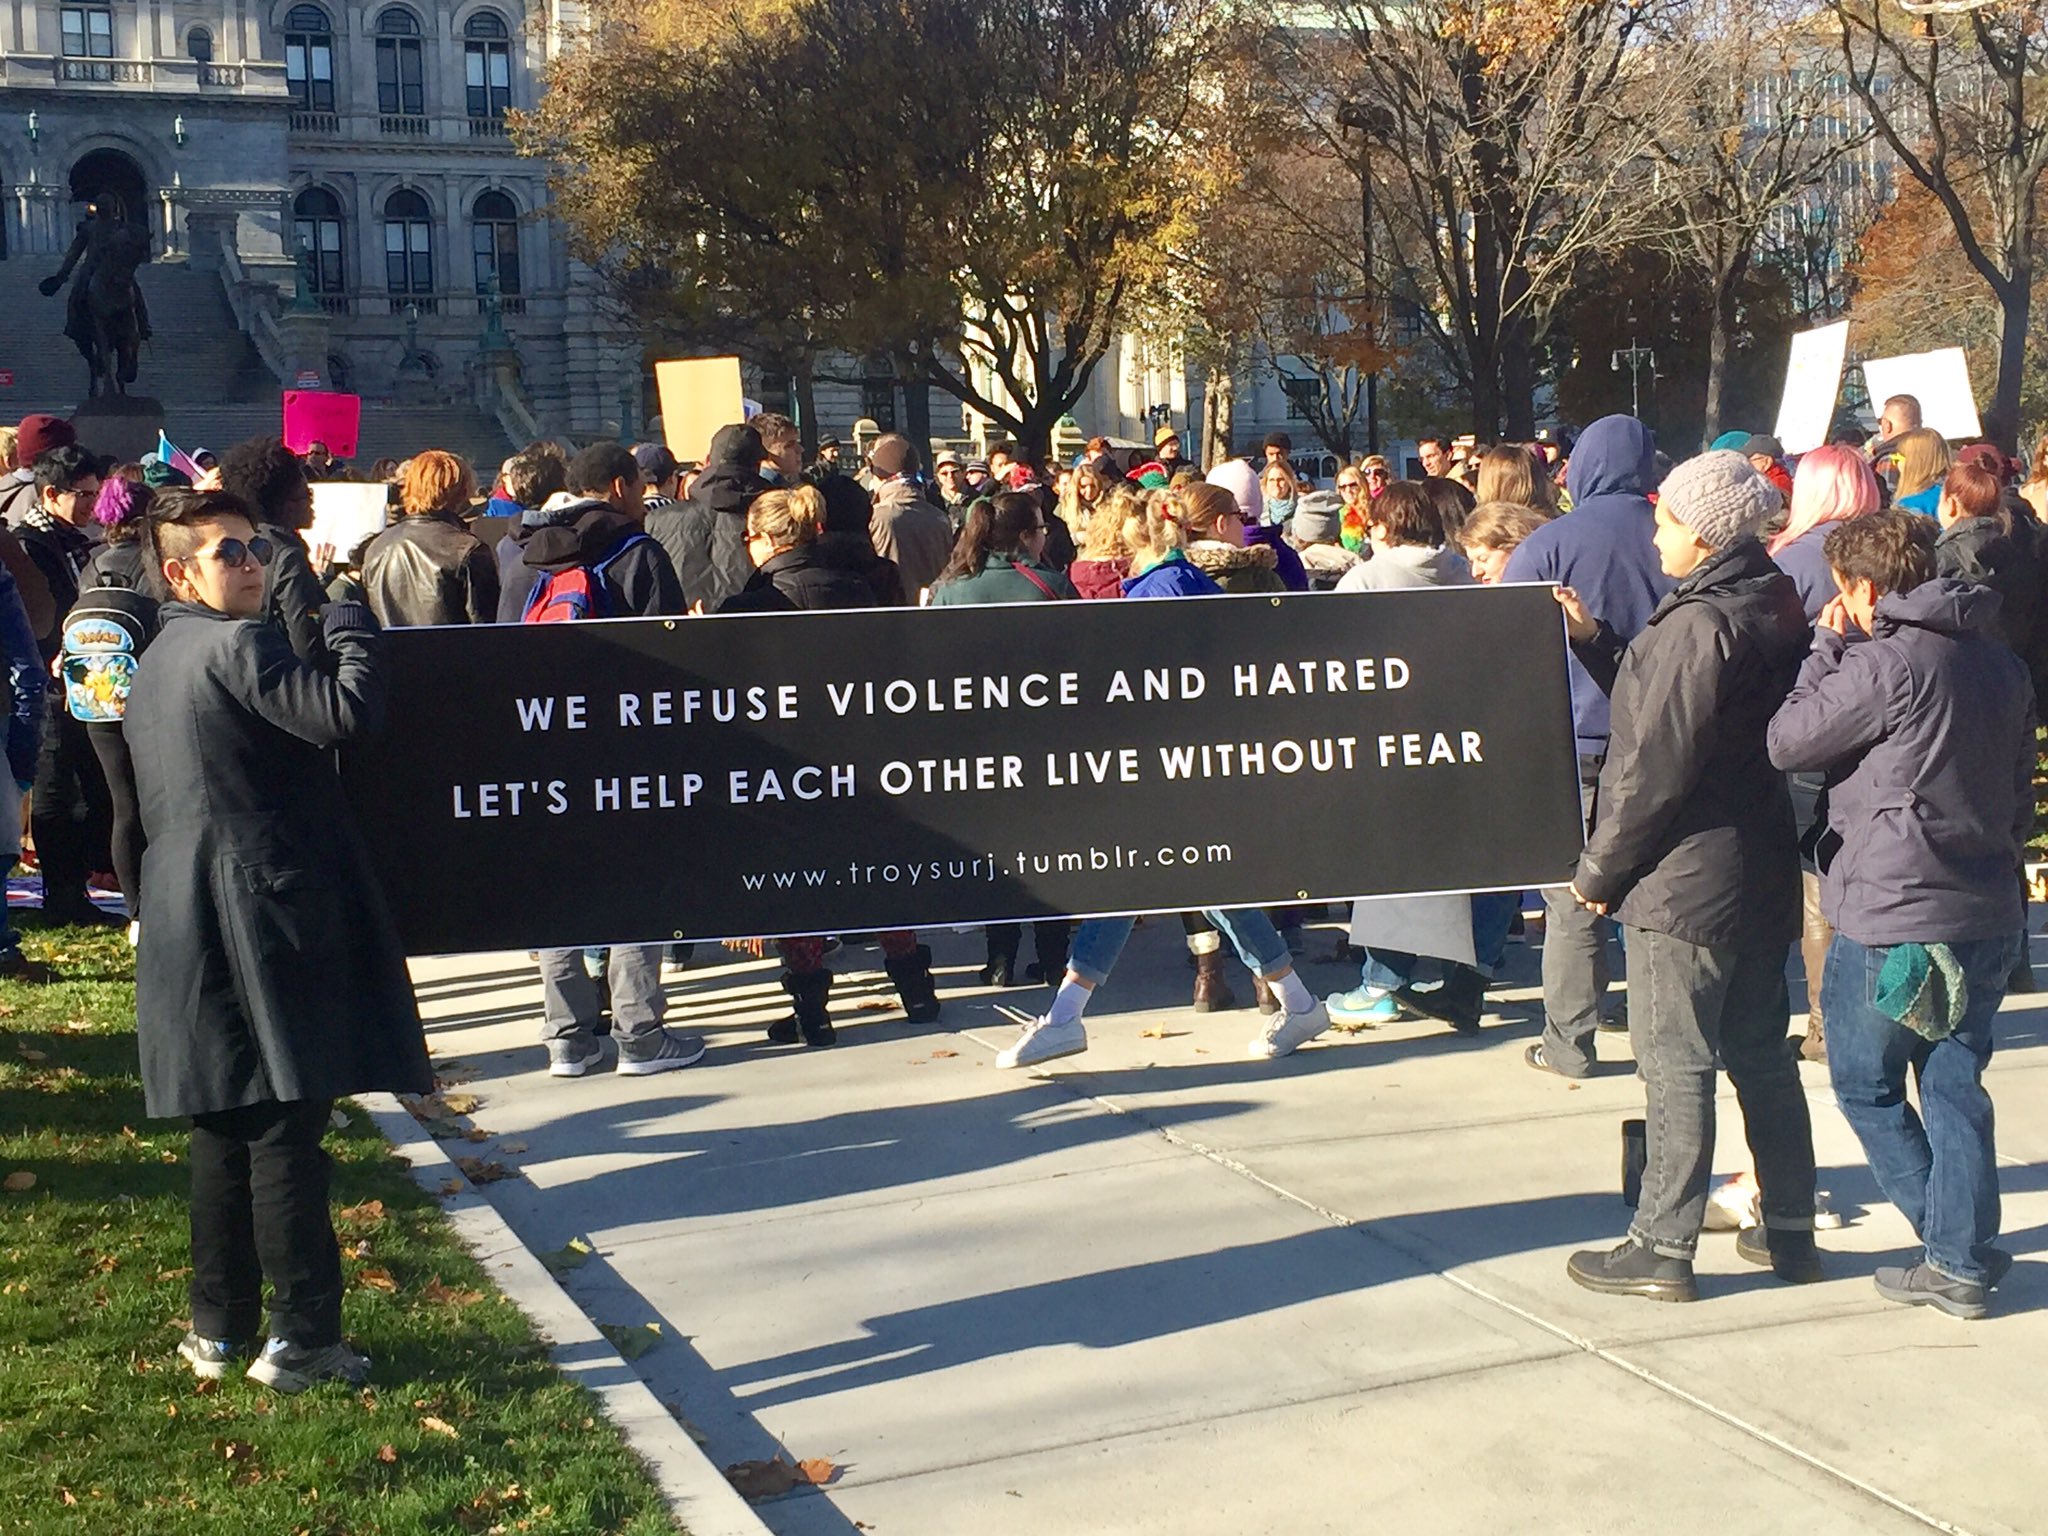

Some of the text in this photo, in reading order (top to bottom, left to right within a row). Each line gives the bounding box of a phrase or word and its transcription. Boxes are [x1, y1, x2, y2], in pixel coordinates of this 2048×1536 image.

[515, 658, 1410, 732] WE REFUSE VIOLENCE AND HATRED
[453, 730, 1484, 818] LET'S HELP EACH OTHER LIVE WITHOUT FEAR
[742, 843, 1232, 891] www.troysurj.tumblr.com
